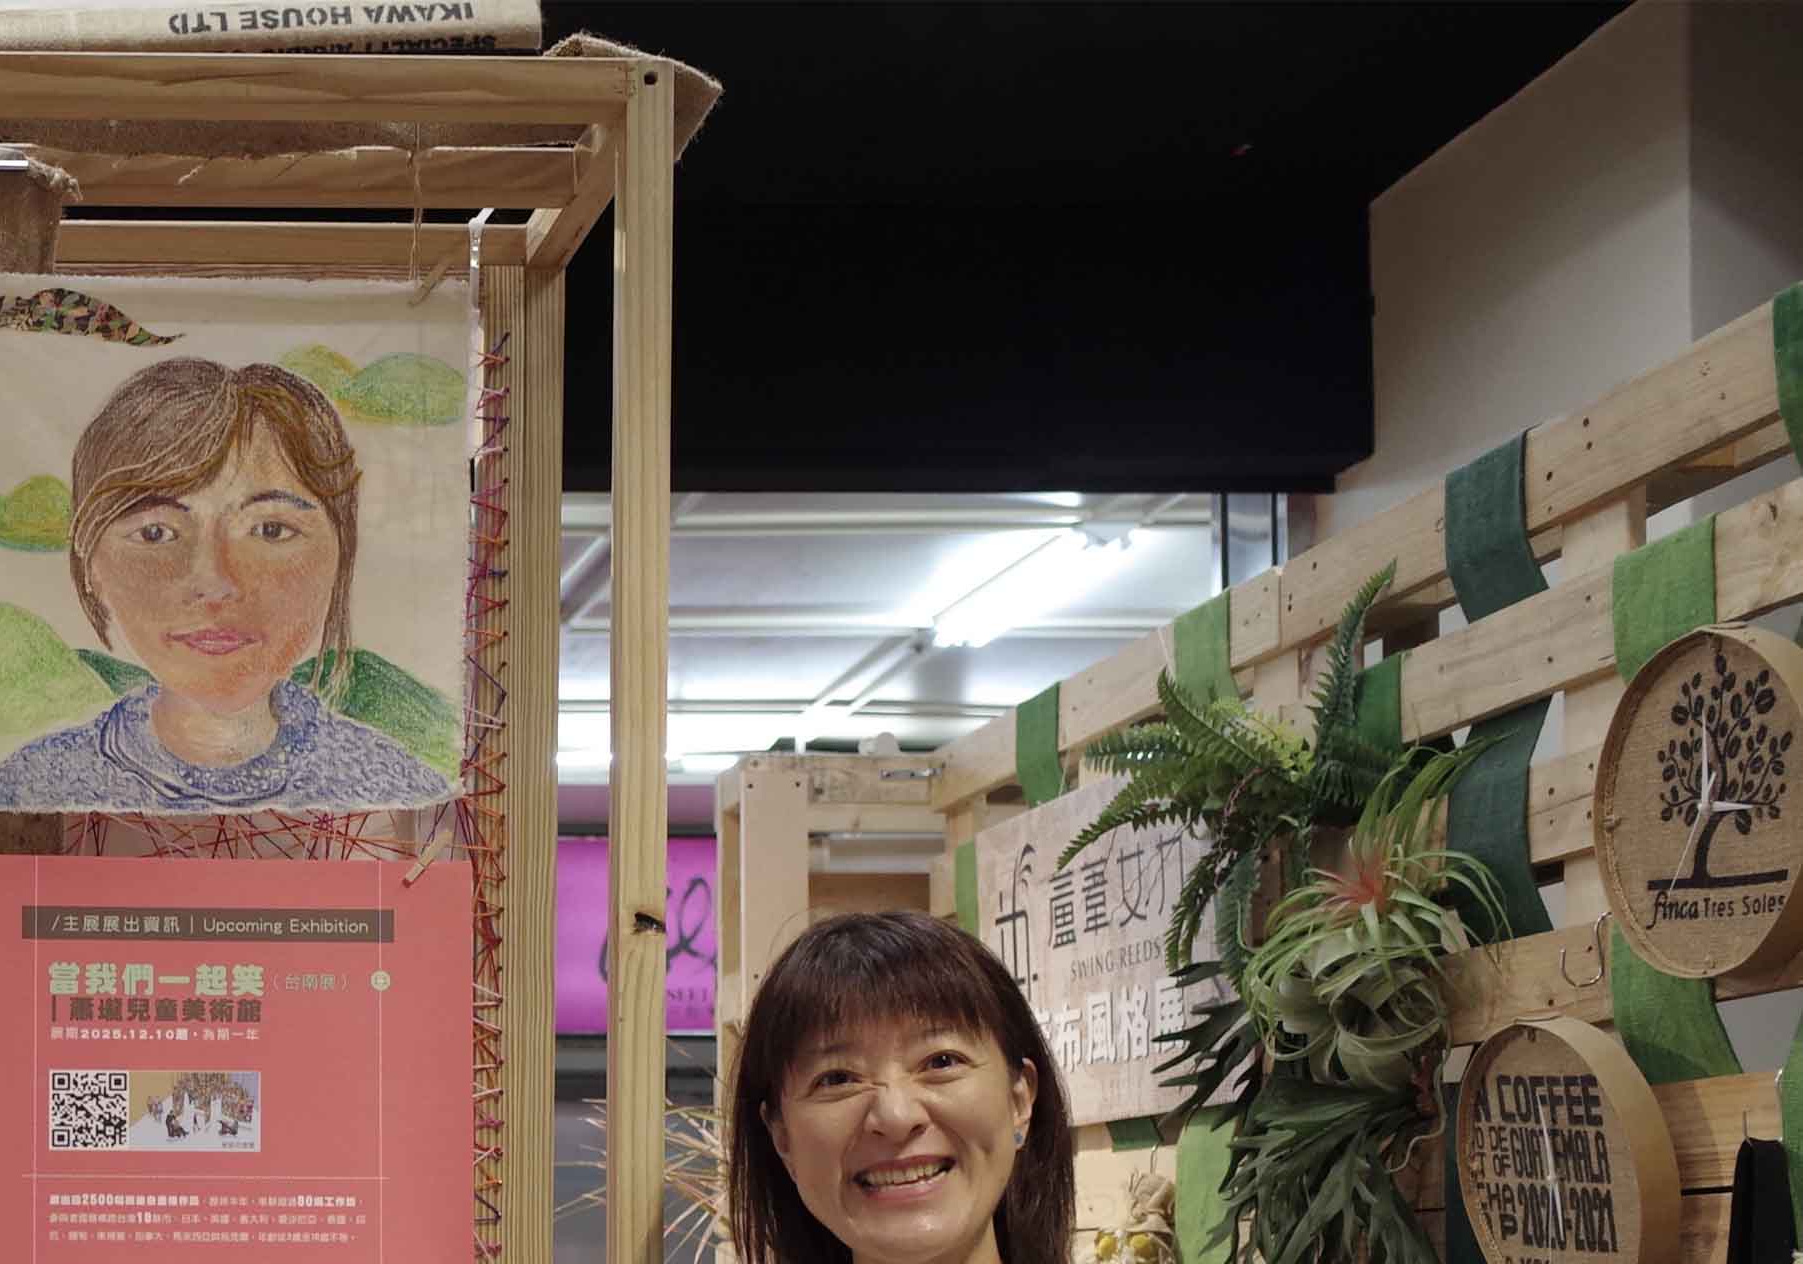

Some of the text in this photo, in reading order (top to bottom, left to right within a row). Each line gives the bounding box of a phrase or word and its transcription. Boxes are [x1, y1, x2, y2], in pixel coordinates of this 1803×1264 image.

[239, 7, 351, 31] HOUSE
[1702, 897, 1735, 919] Tres
[1741, 893, 1786, 916] Soles
[203, 917, 283, 937] Upcoming
[289, 917, 370, 936] Exhibition
[48, 962, 265, 997] 當我們一起笑
[1497, 1074, 1604, 1127] COFFEE
